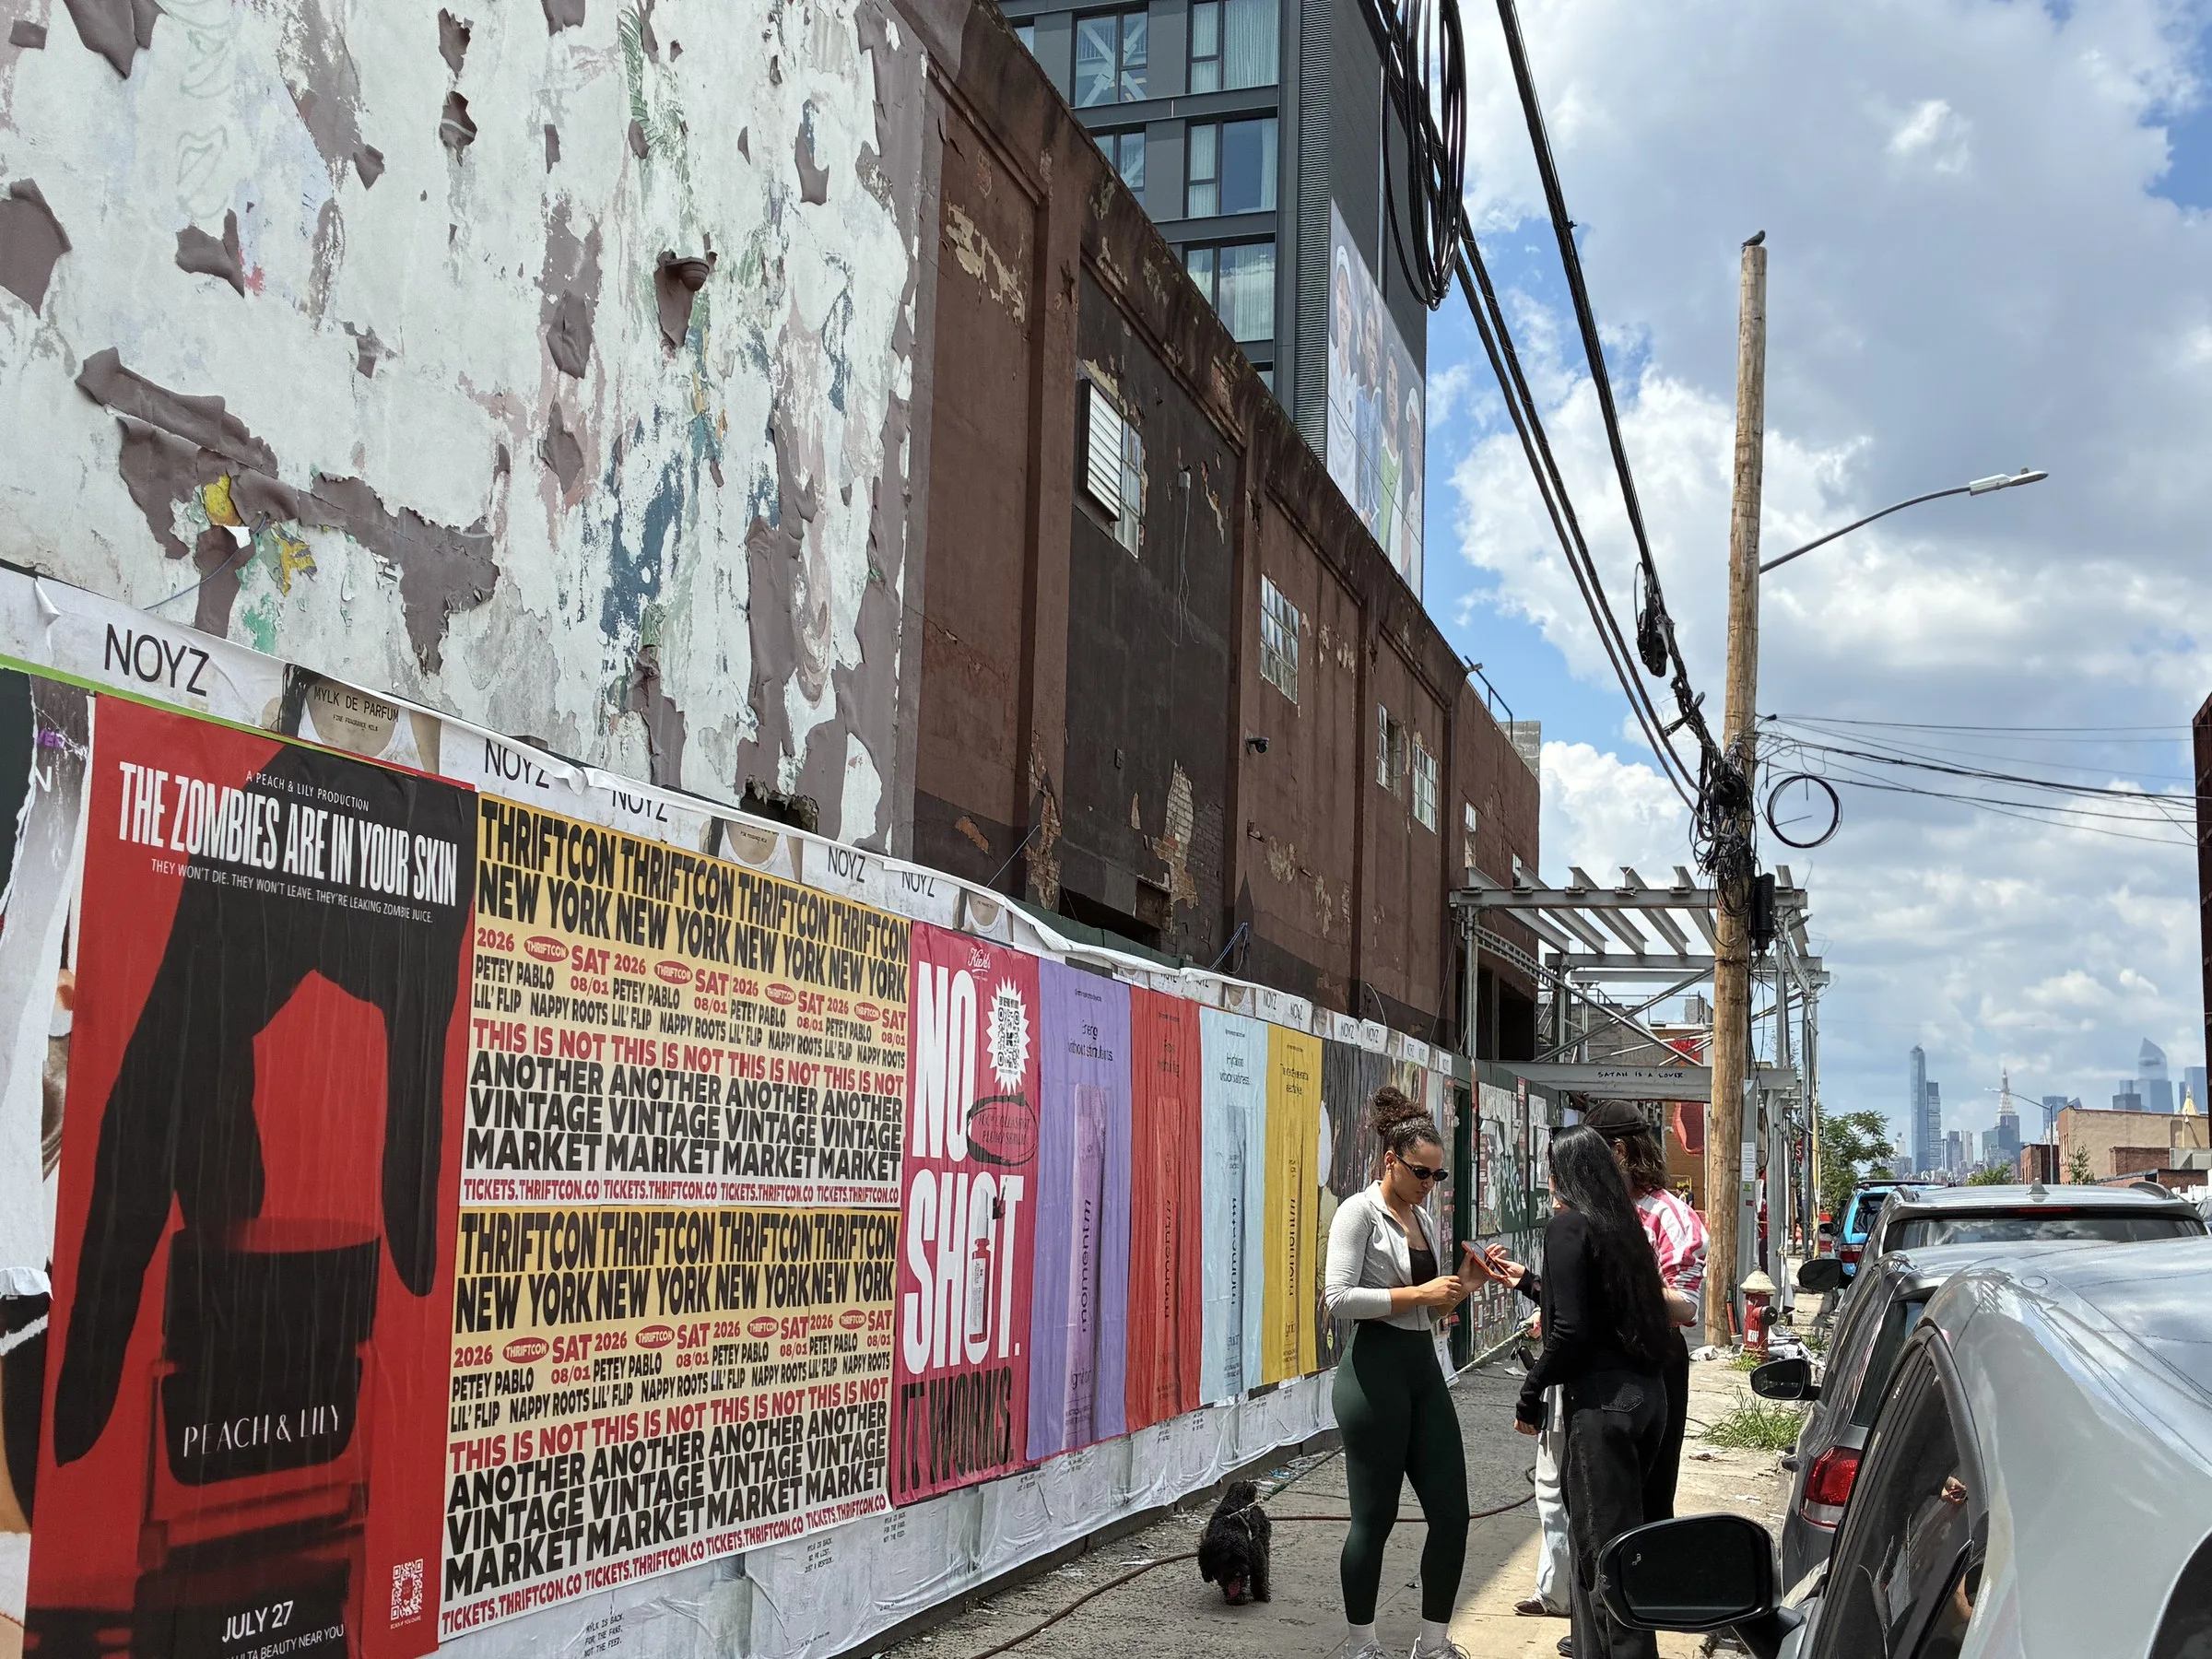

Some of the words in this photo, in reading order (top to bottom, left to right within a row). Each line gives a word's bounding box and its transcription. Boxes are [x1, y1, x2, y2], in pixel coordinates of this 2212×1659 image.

[104, 623, 209, 697] NOYZ
[313, 686, 339, 707] MYLK
[345, 695, 358, 712] DE
[363, 700, 399, 723] PARFUM
[245, 771, 253, 782] A
[256, 772, 285, 790] PEACH
[288, 781, 294, 793] &
[297, 782, 314, 797] LILY
[317, 788, 369, 812] PRODUCTION
[119, 761, 169, 848] THE
[170, 774, 280, 870] ZOMBIES
[282, 802, 329, 880] ARE
[330, 814, 355, 886] IN
[359, 819, 410, 897] YOUR
[413, 834, 458, 907] SKIN
[481, 798, 617, 889] THRIFTCON
[151, 858, 175, 875] THEY
[178, 864, 210, 882] WON'T
[212, 870, 229, 886] DIE.
[231, 874, 254, 889] THEY
[256, 878, 286, 895] WON'T
[287, 885, 314, 900] LEAVE.
[316, 889, 348, 907] THEY'RE
[349, 896, 382, 913] LEAKING
[383, 902, 410, 919] ZOMBIE
[620, 837, 735, 917] THRIFTCON
[828, 845, 866, 884] NOYZ
[478, 860, 541, 924] NEW
[547, 877, 612, 940] YORK
[738, 872, 830, 943] THRIFTCON
[477, 927, 515, 953] 2026
[526, 939, 566, 959] THRIFTCON
[571, 944, 611, 976] SAT
[616, 893, 670, 950] NEW
[676, 907, 732, 964] YORK
[832, 900, 909, 964] THRIFTCON
[476, 954, 513, 983] PETEY
[516, 961, 554, 990] PABLO
[570, 975, 609, 996] 08/01
[734, 922, 779, 973] NEW
[782, 935, 827, 986] YORK
[829, 947, 865, 994] NEW
[868, 957, 907, 1004] YORK
[474, 983, 494, 1009] LIL'
[497, 986, 522, 1013] FLIP
[530, 993, 570, 1019] NAPPY
[572, 998, 607, 1025] ROOTS
[472, 1018, 527, 1054] THIS
[533, 1025, 554, 1057] IS
[559, 1029, 606, 1062] NOT
[911, 960, 977, 1164] NO
[470, 1051, 604, 1095] ANOTHER
[823, 1065, 856, 1092] THIS
[858, 1070, 871, 1093] IS
[874, 1073, 904, 1097] NOT
[470, 1087, 603, 1133] VINTAGE
[466, 1128, 602, 1171] MARKET
[606, 1134, 720, 1174] MARKET
[723, 1141, 816, 1178] MARKET
[818, 1147, 900, 1182] MARKET
[464, 1178, 600, 1201] TICKETS.THRIFTCON.CO
[603, 1179, 718, 1200] TICKETS.THRIFTCON.CO
[720, 1182, 814, 1203] TICKETS.THRIFTCON.CO
[817, 1185, 900, 1204] TICKETS.THRIFTCON.CO
[461, 1211, 598, 1275] THRIFTCON
[600, 1211, 715, 1267] THRIFTCON
[720, 1211, 813, 1263] THRIFTCON
[815, 1214, 898, 1260] THRIFTCON
[595, 1268, 651, 1321] NEW
[656, 1265, 712, 1316] YORK
[714, 1264, 760, 1311] NEW
[764, 1264, 810, 1309] YORK
[811, 1262, 850, 1304] NEW
[853, 1261, 894, 1302] YORK
[902, 1168, 1024, 1374] SHOT.
[455, 1275, 522, 1334] NEW
[528, 1271, 594, 1327] YORK
[594, 1331, 628, 1352] 2026
[638, 1330, 671, 1345] THRIFTCON
[677, 1322, 712, 1350] SAT
[592, 1384, 609, 1410] LIL'
[612, 1382, 633, 1407] FLIP
[641, 1376, 676, 1403] NAPPY
[677, 1371, 708, 1397] ROOTS
[594, 1356, 627, 1382] PETEY
[629, 1352, 662, 1378] PABLO
[676, 1351, 710, 1369] 08/01
[183, 1414, 270, 1457] PEACH
[276, 1414, 291, 1442] &
[300, 1404, 338, 1438] LILY
[591, 1412, 640, 1447] THIS
[642, 1408, 662, 1439] IS
[665, 1401, 708, 1435] NOT
[900, 1382, 924, 1493] IT
[589, 1430, 704, 1483] ANOTHER
[589, 1462, 704, 1520] VINTAGE
[707, 1476, 803, 1529] MARKET
[806, 1457, 886, 1505] MARKET
[586, 1496, 705, 1561] MARKET
[705, 1516, 804, 1554] TICKETS.THRIFTCON.CO
[806, 1494, 887, 1528] TICKETS.THRIFTCON.CO
[444, 1524, 584, 1602] MARKET
[584, 1539, 705, 1588] TICKETS.THRIFTCON.CO
[221, 1606, 268, 1643] JULY
[271, 1599, 294, 1629] 27
[441, 1572, 582, 1633] TICKETS.THRIFTCON.CO
[260, 1637, 298, 1659] BEAUTY
[298, 1630, 323, 1649] NEAR
[324, 1623, 345, 1640] YOU
